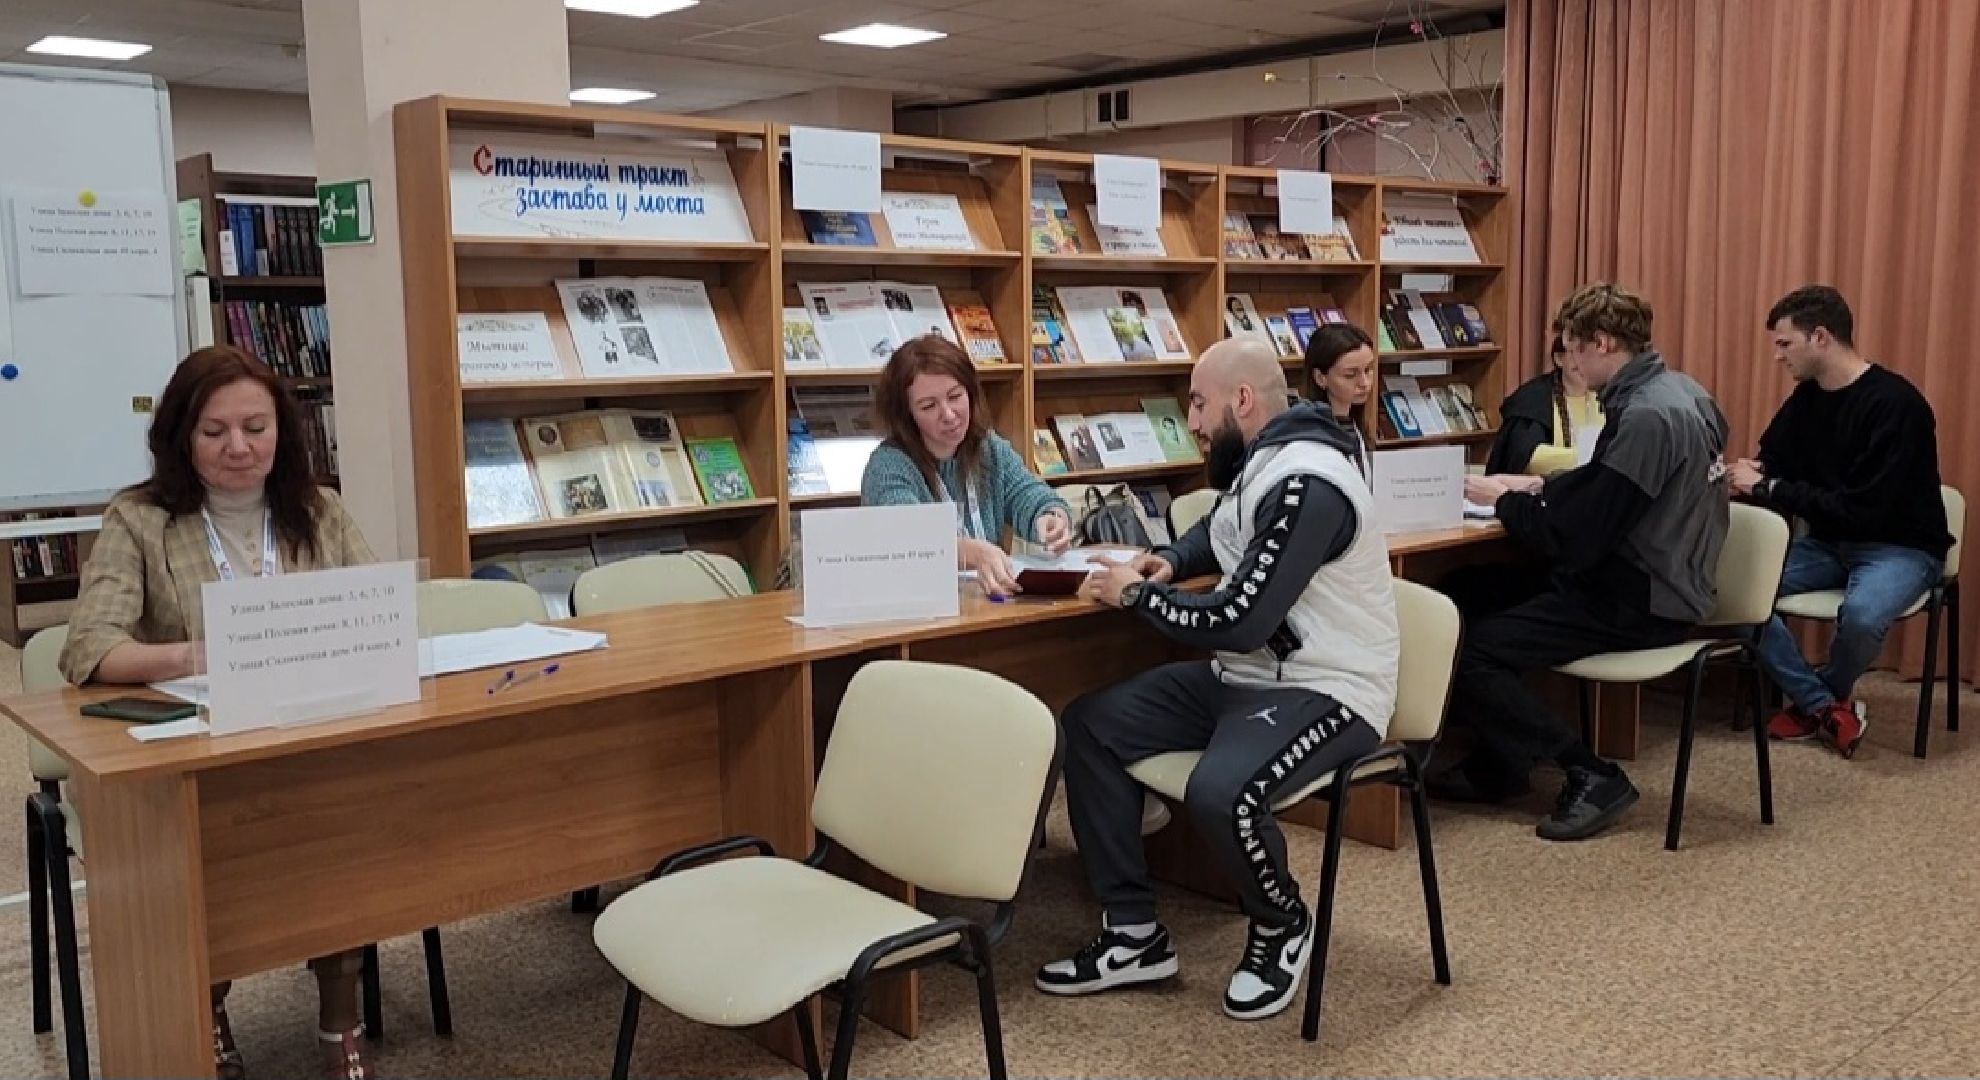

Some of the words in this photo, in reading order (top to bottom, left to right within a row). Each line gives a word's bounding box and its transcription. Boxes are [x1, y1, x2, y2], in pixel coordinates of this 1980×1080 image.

[473, 144, 611, 186] Старинный
[618, 163, 691, 191] тракт
[516, 182, 609, 217] застава
[616, 194, 628, 221] у
[634, 192, 705, 215] моста
[1223, 538, 1280, 622] JORDAN
